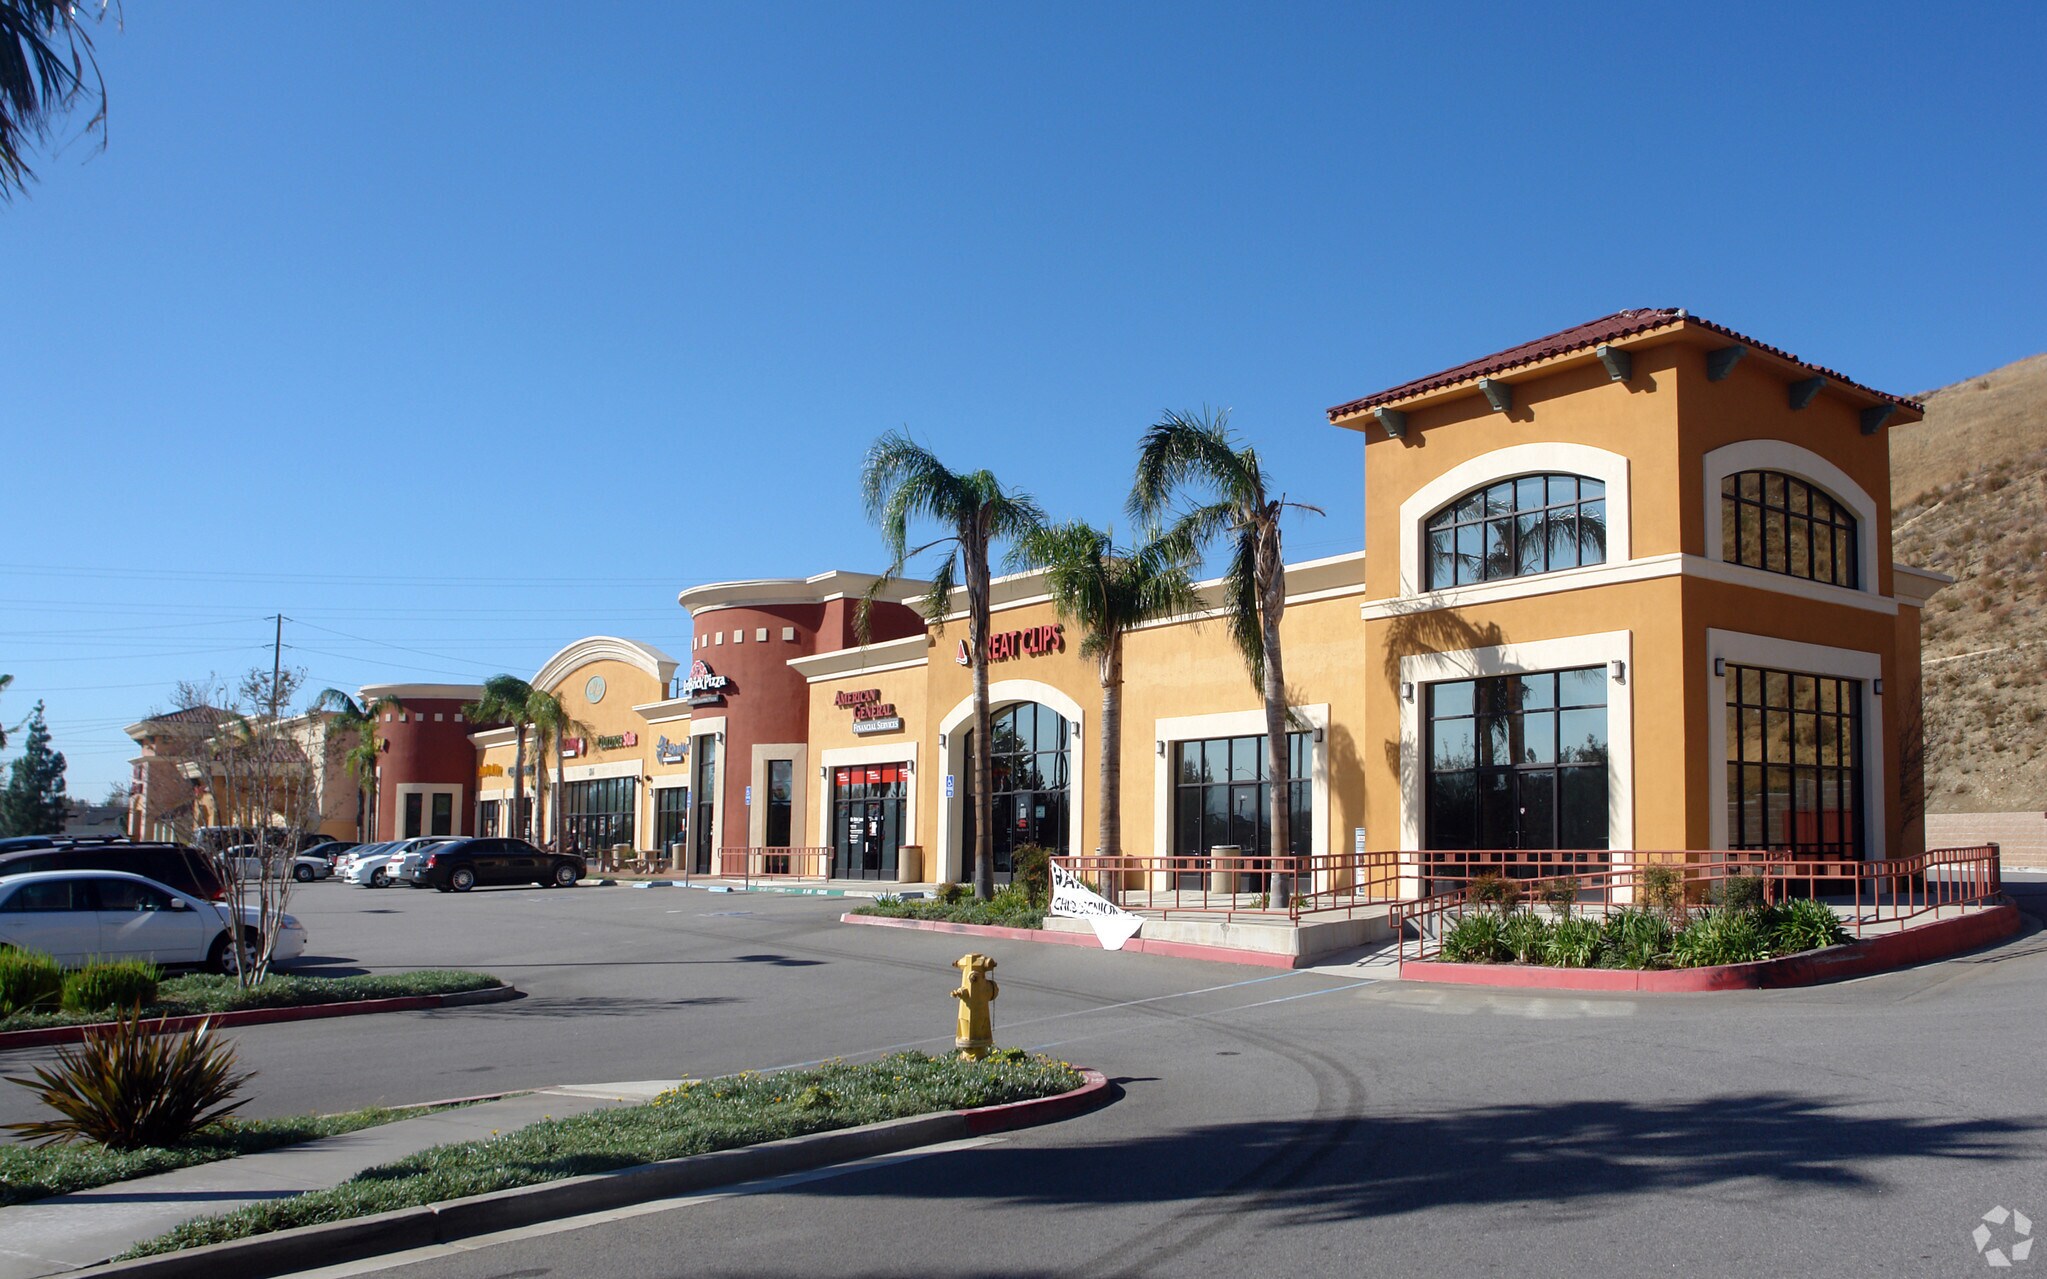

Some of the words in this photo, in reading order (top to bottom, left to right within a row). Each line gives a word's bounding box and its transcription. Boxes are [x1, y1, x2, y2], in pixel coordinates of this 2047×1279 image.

[987, 630, 1017, 660] REAT
[1021, 623, 1061, 654] CLIPS
[702, 673, 726, 690] Pizza
[834, 688, 877, 706] AMERICAN
[853, 703, 892, 720] GENERAL
[877, 720, 899, 731] SERVICES
